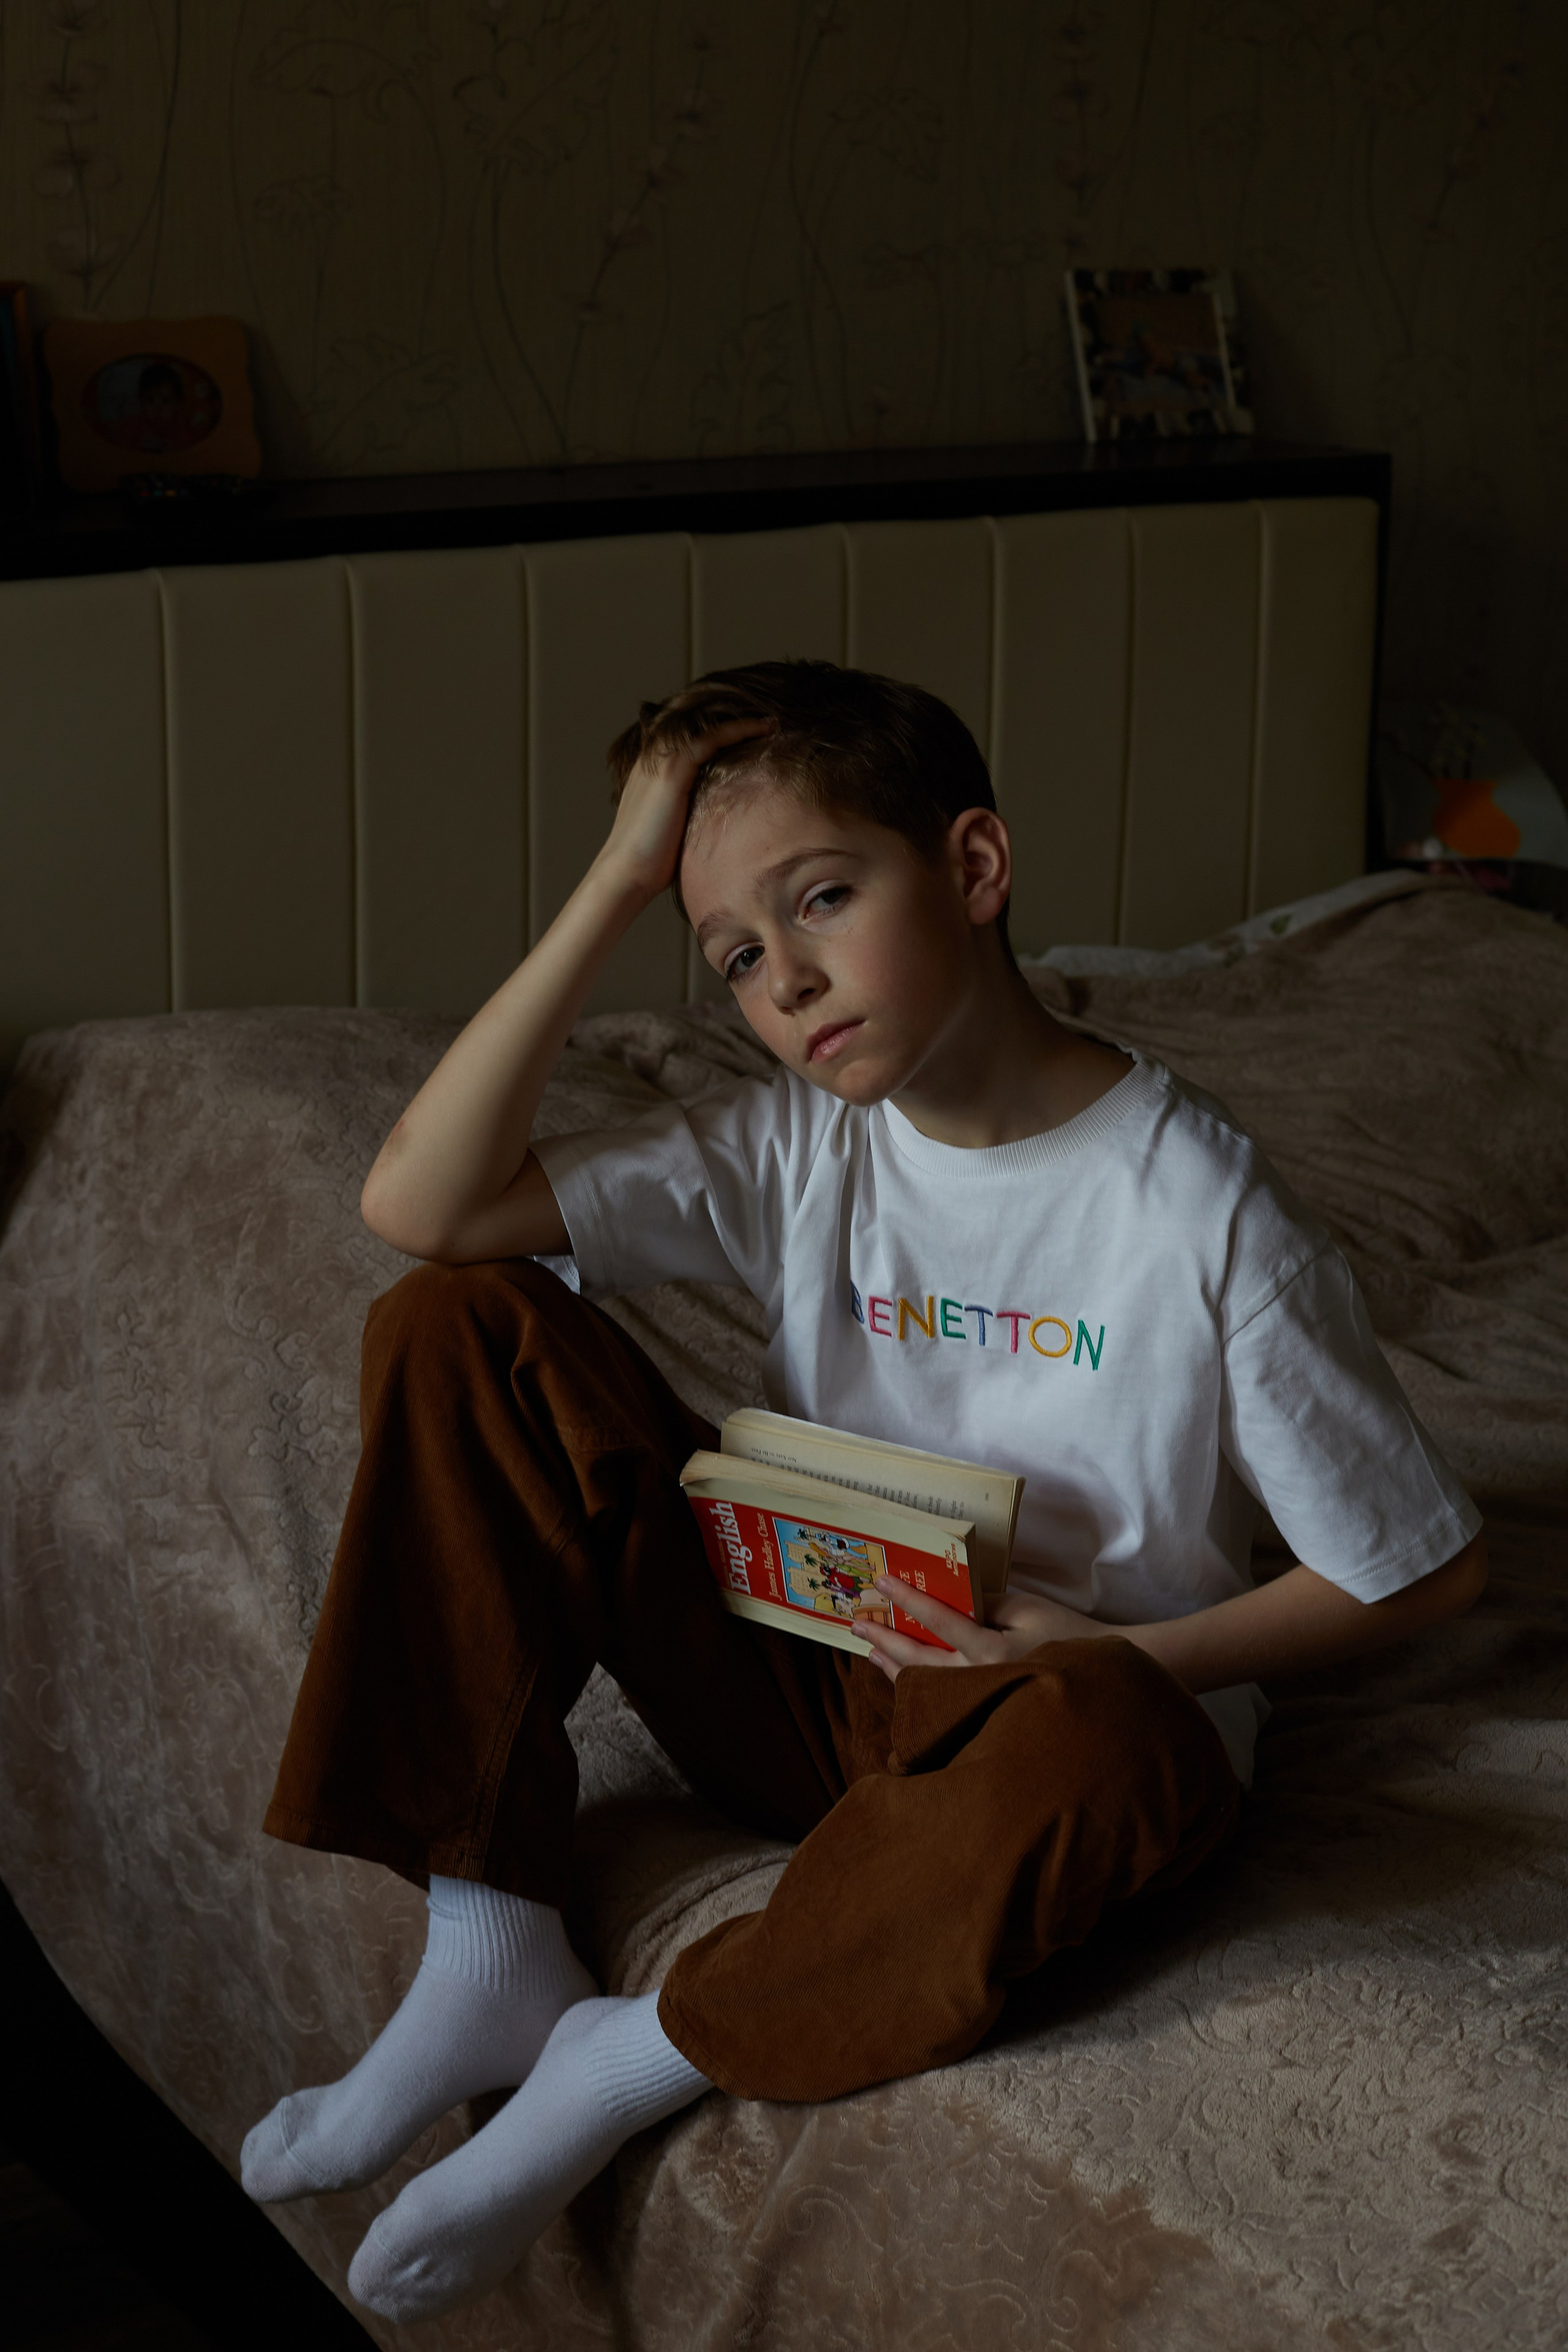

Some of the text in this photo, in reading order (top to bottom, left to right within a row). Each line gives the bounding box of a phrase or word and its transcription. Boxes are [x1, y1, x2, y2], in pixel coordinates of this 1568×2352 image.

[850, 1281, 1105, 1371] BENETTON
[709, 1501, 753, 1595] English
[757, 1512, 782, 1601] James Hadley Chase
[915, 1570, 926, 1593] REE
